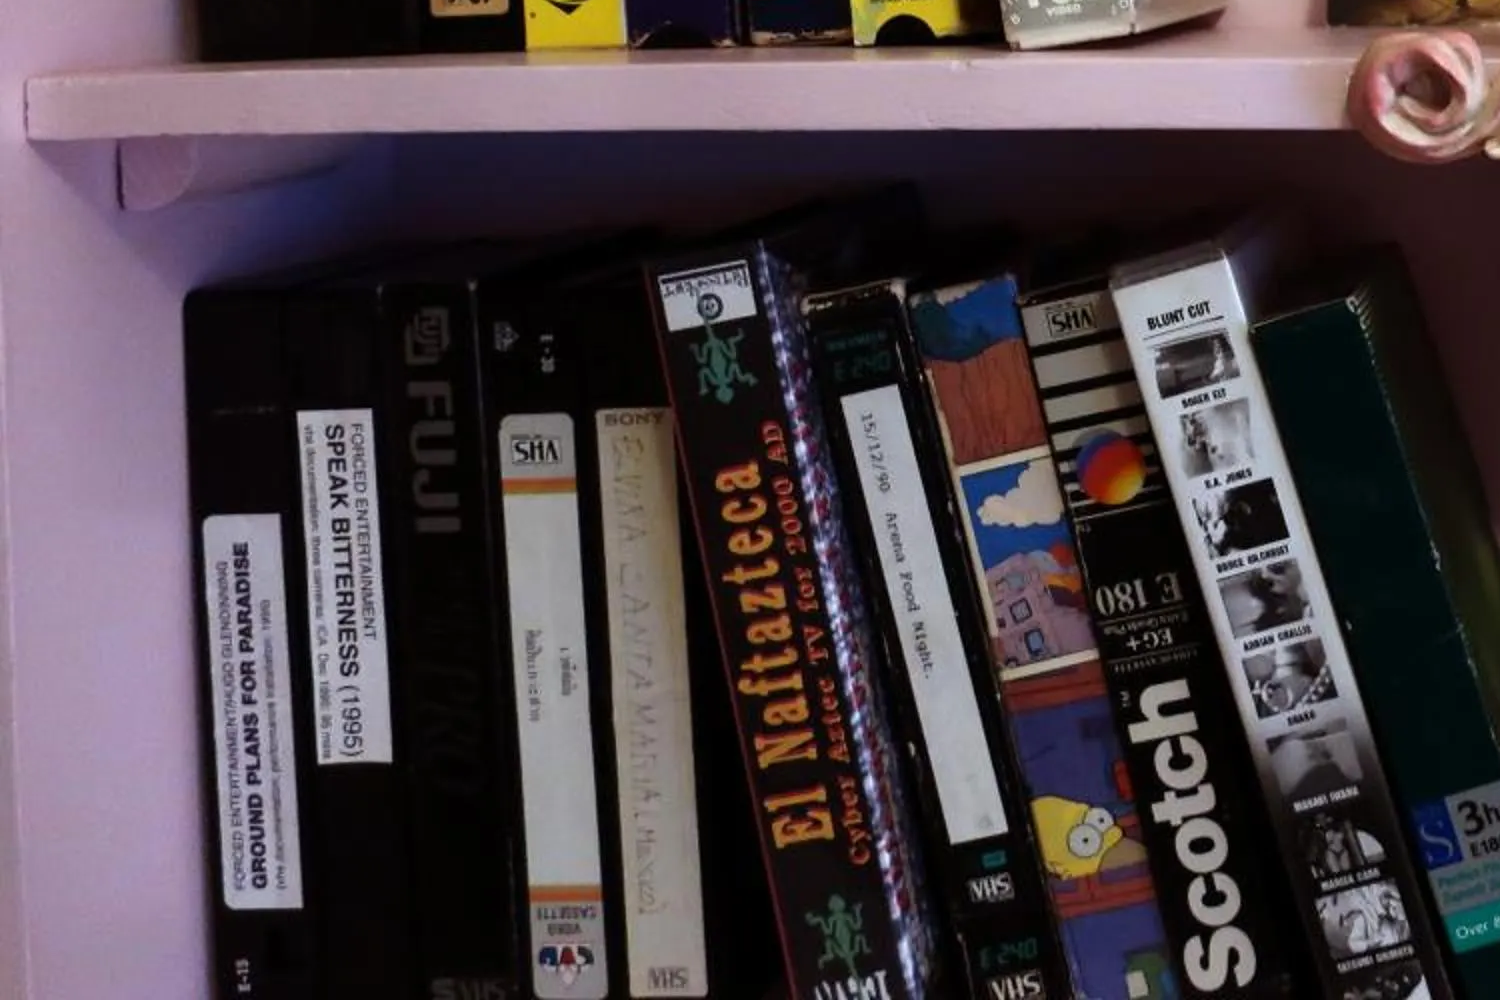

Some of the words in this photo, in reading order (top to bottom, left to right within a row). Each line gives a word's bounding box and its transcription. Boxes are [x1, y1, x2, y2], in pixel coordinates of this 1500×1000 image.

[1051, 307, 1092, 332] VHS
[1147, 309, 1185, 331] BLUNT
[1187, 301, 1211, 318] CUT
[514, 439, 558, 462] VHS
[604, 413, 663, 427] SONY
[760, 419, 790, 464] AD
[324, 424, 349, 509] SPEAK
[349, 423, 368, 492] FORCED
[407, 381, 462, 533] FUJI
[771, 475, 807, 556] 2000
[857, 410, 893, 495] 15/12/90
[882, 510, 909, 563] Arena
[898, 568, 921, 612] Food
[232, 540, 255, 652] PARADISE
[330, 516, 359, 677] BITTERNESS
[354, 497, 377, 640] ENTERTAINMENT
[795, 567, 818, 613] for
[715, 459, 819, 771] Naftazteca
[803, 624, 829, 666] TV
[239, 660, 258, 704] FOR
[241, 712, 262, 785] PLANS
[336, 684, 363, 758] (1995)
[818, 678, 850, 764] Aztec
[245, 792, 268, 889] GROUND
[764, 784, 834, 851] El
[836, 774, 871, 866] Cyber
[1128, 678, 1258, 992] Scotch
[230, 831, 246, 890] FORCED
[968, 872, 1010, 900] VHS
[1455, 920, 1489, 940] Over
[989, 968, 1042, 1000] VHS
